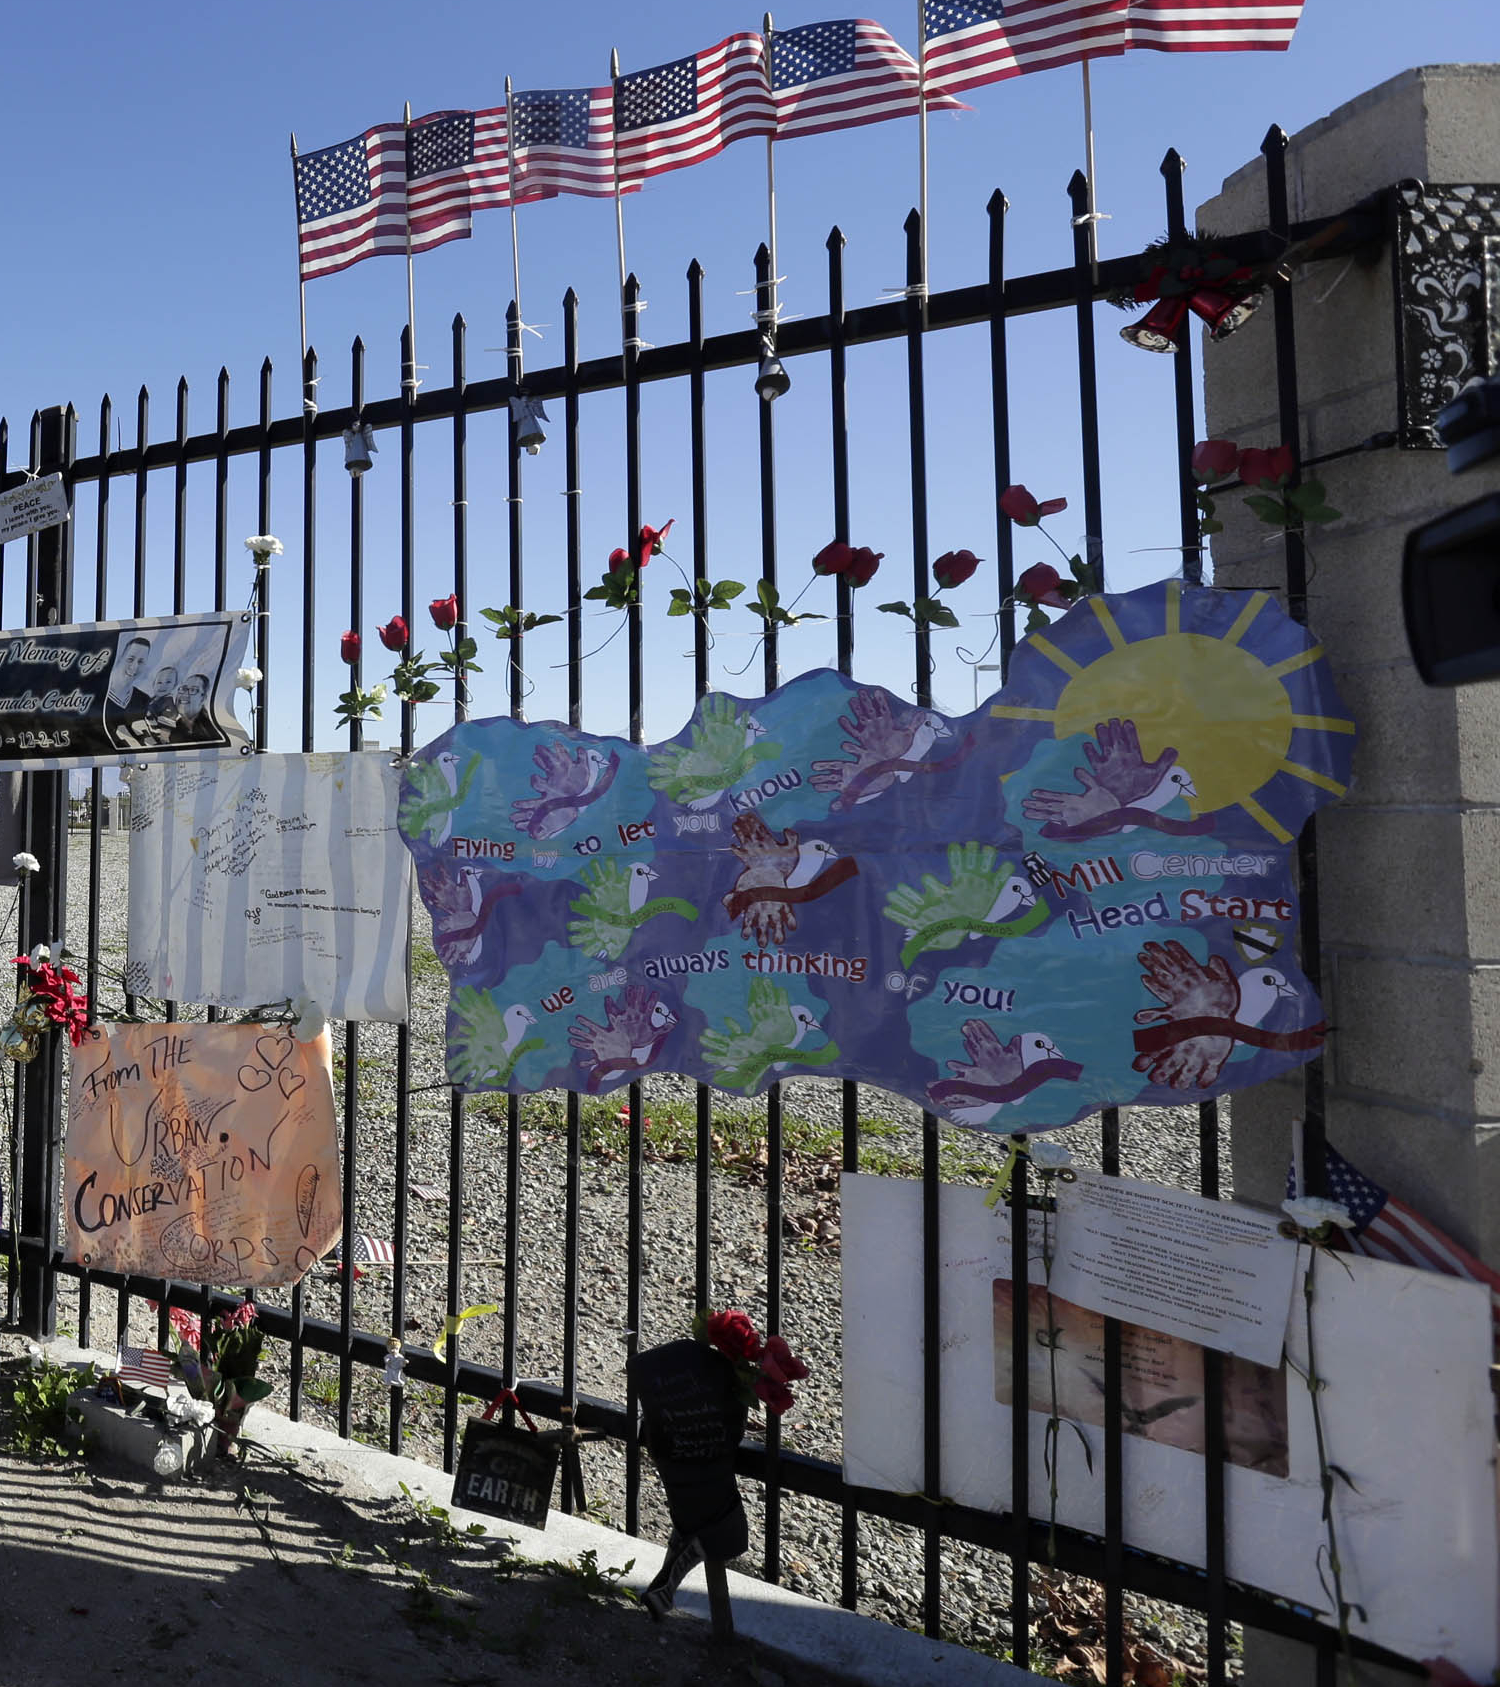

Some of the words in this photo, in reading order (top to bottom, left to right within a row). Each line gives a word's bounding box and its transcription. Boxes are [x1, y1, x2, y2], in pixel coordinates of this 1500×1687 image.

[13, 497, 41, 513] PEACE
[26, 508, 38, 516] with
[9, 640, 77, 669] Memory
[42, 689, 94, 715] Godoy
[18, 730, 71, 749] 12-2-15
[452, 837, 516, 863] Flying
[573, 835, 601, 856] to
[617, 819, 656, 847] let
[673, 812, 721, 837] you
[729, 767, 803, 815] know
[265, 889, 279, 899] God
[1050, 856, 1125, 899] Mill
[1129, 850, 1279, 880] Center
[1067, 892, 1172, 939] Head
[1179, 889, 1293, 922] Start
[540, 986, 575, 1014] we
[588, 967, 628, 993] are
[645, 949, 730, 979] always
[741, 949, 868, 983] thinking
[943, 980, 1016, 1012] you!
[82, 1051, 141, 1098] From
[143, 1035, 192, 1078] THE
[74, 1110, 291, 1233] CONSERVATION
[467, 1472, 540, 1513] EARTH
